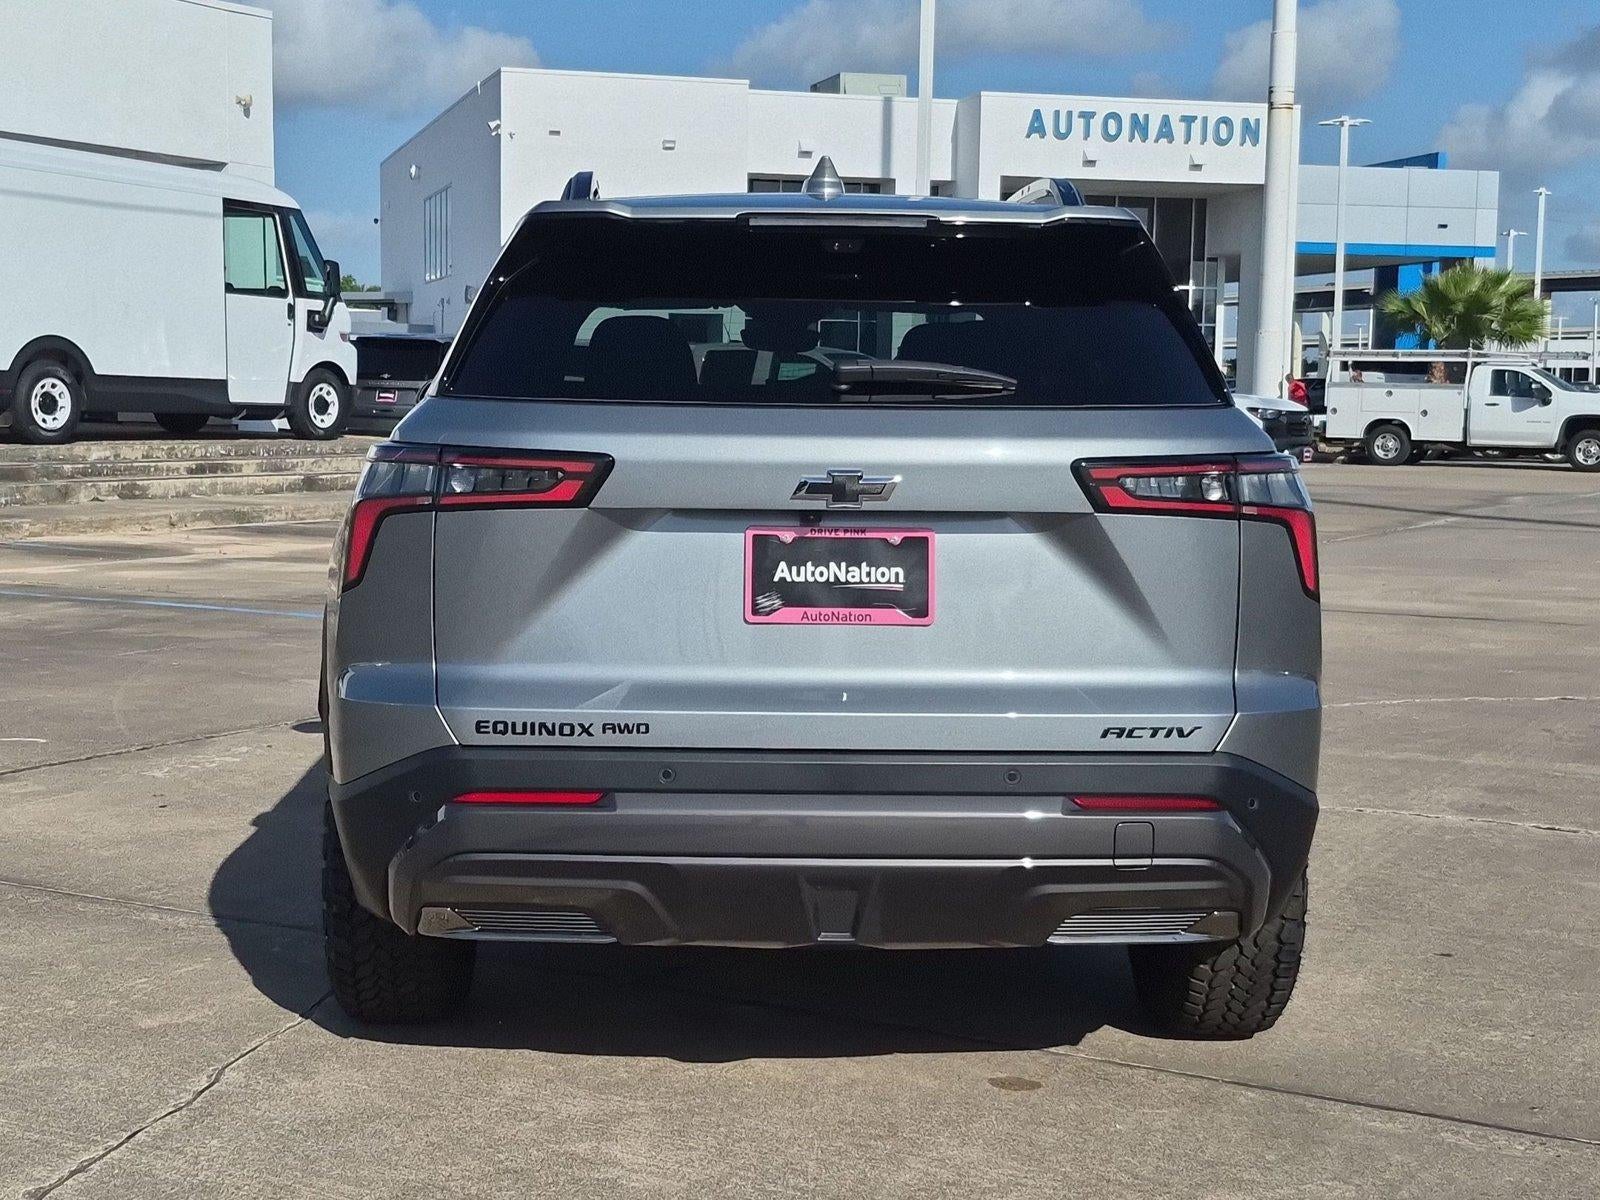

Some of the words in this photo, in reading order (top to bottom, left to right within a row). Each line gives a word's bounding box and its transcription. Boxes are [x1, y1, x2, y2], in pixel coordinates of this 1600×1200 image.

[1025, 109, 1260, 147] AUTONATION
[810, 528, 840, 536] DRIVE
[843, 528, 867, 536] PINK
[773, 561, 905, 583] AutoNation
[801, 611, 872, 622] AutoNation
[475, 720, 595, 737] EQUINOX
[602, 723, 650, 735] AWD
[1100, 726, 1203, 739] ACTIV
